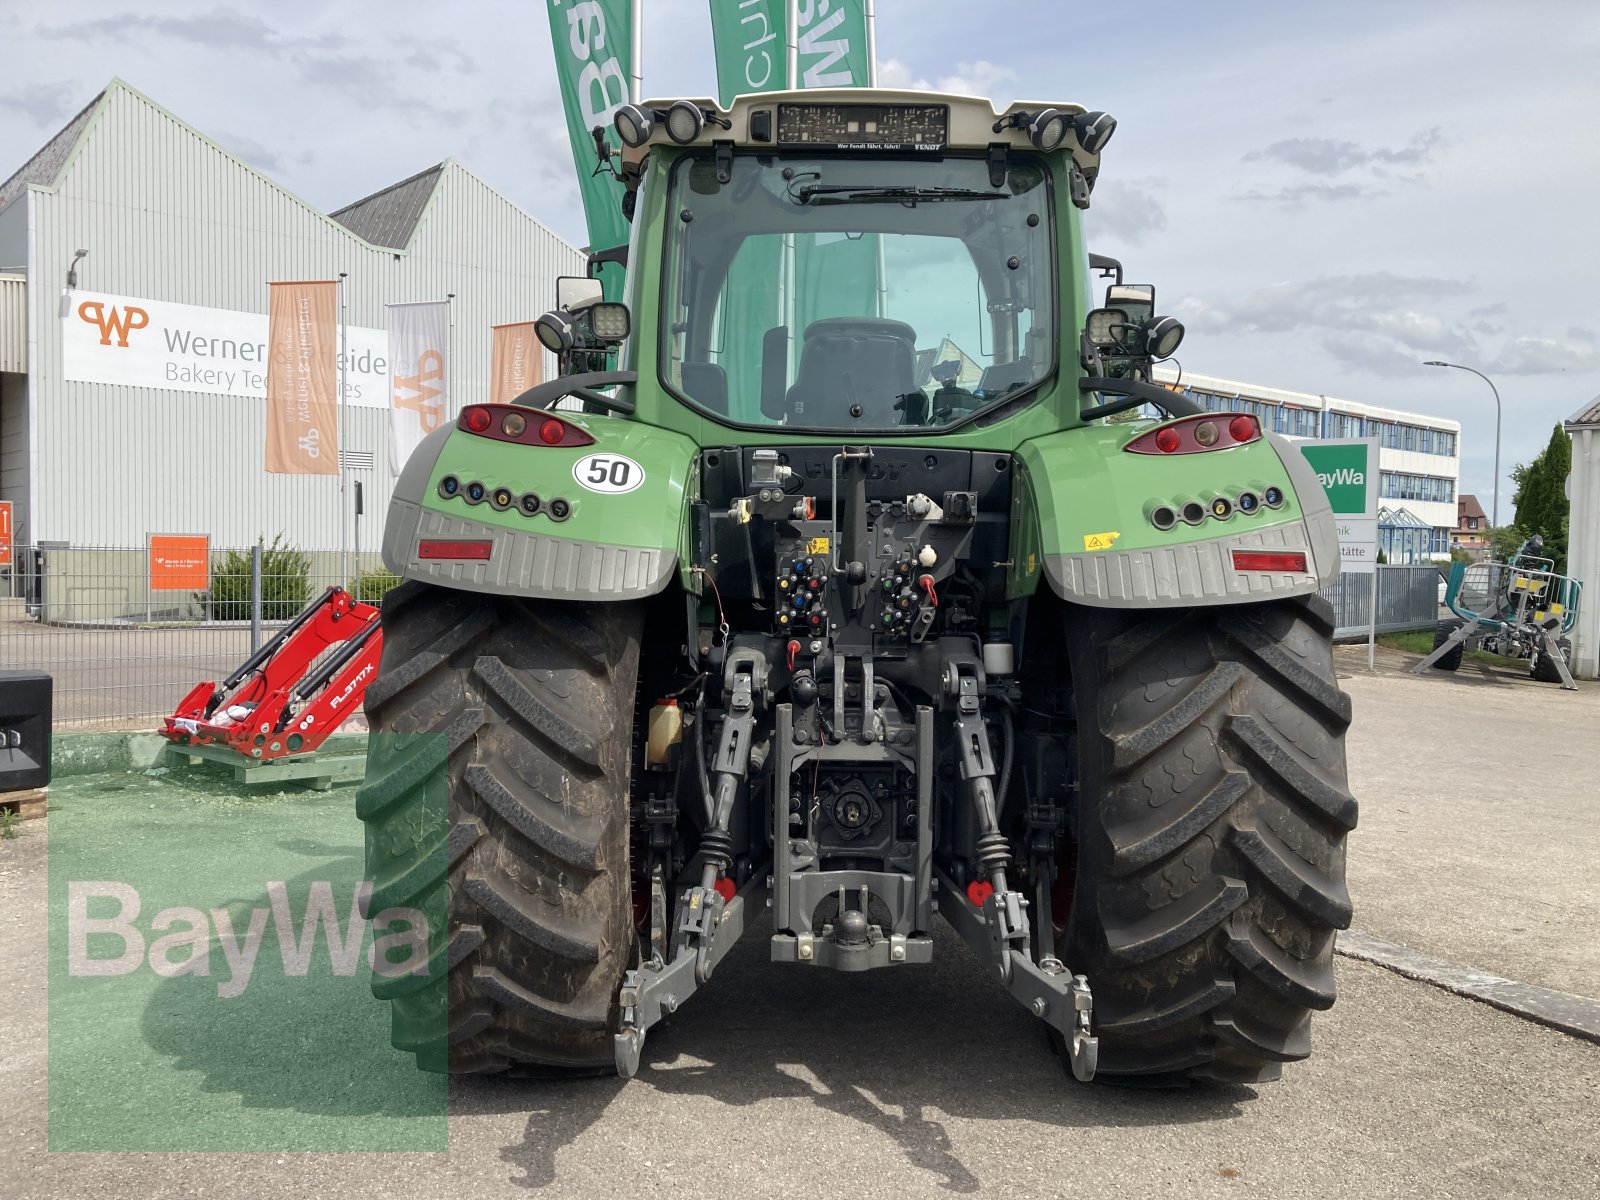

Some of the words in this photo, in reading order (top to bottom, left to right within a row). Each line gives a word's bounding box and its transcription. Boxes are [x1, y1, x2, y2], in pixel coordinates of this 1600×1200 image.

[163, 328, 266, 362] Werner
[165, 362, 236, 391] Bakery
[587, 458, 630, 487] 50
[804, 460, 910, 481] FEDT
[1317, 468, 1364, 489] ayWa
